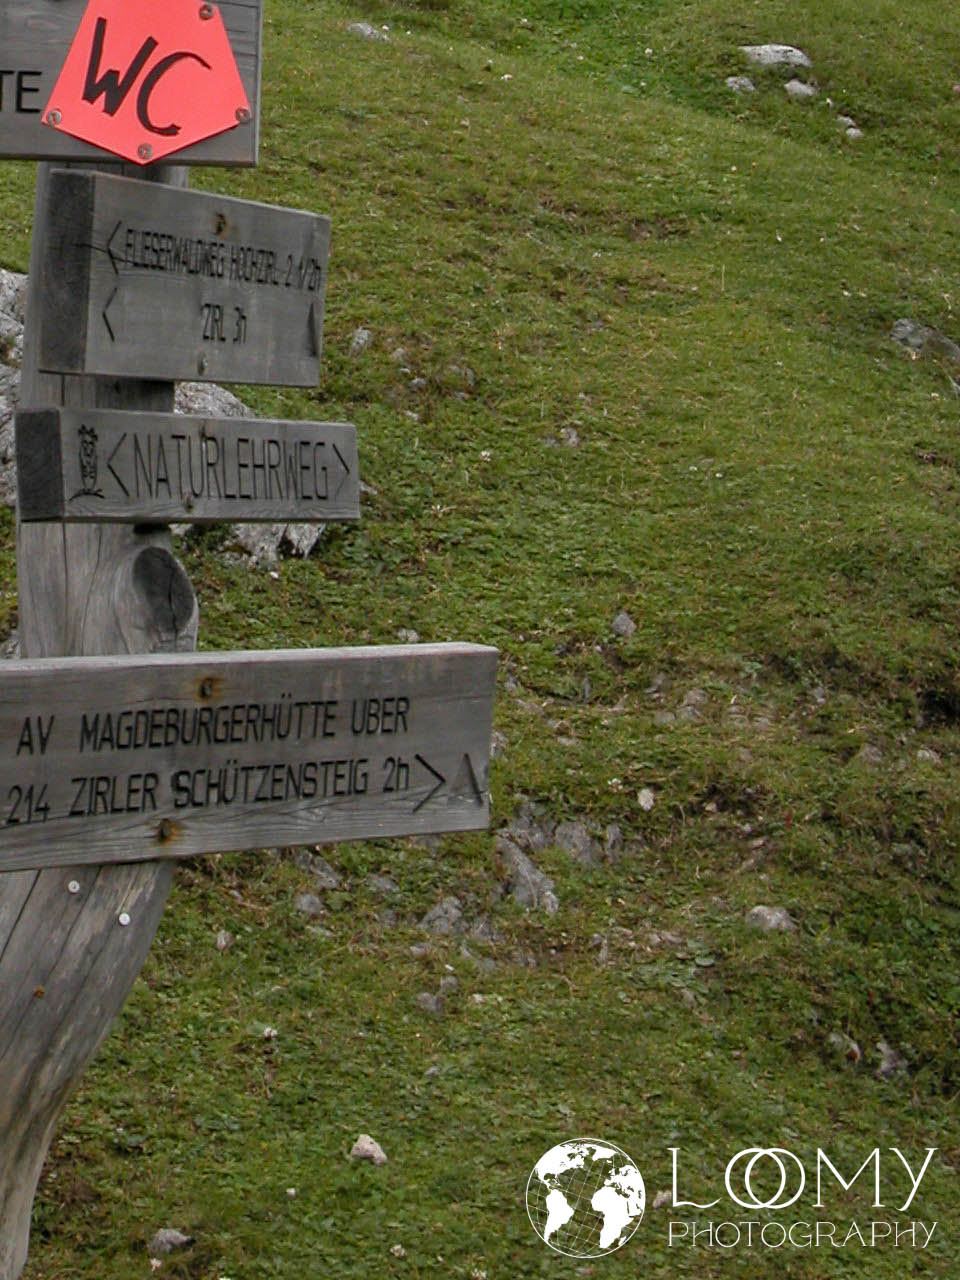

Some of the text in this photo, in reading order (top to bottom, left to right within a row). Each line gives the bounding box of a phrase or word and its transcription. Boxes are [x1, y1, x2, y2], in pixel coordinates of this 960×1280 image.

[80, 16, 212, 137] WC
[231, 241, 280, 286] HOCHZIRL
[285, 253, 293, 287] 2
[200, 302, 247, 344] ZIRL 3h
[133, 432, 329, 501] NATURLEHRWEG
[16, 714, 55, 756] AV
[79, 693, 338, 753] MAGDEBURGERHÜTTE
[7, 755, 410, 825] 214 ZIRLER SCHÜTZENSTEIG 2h
